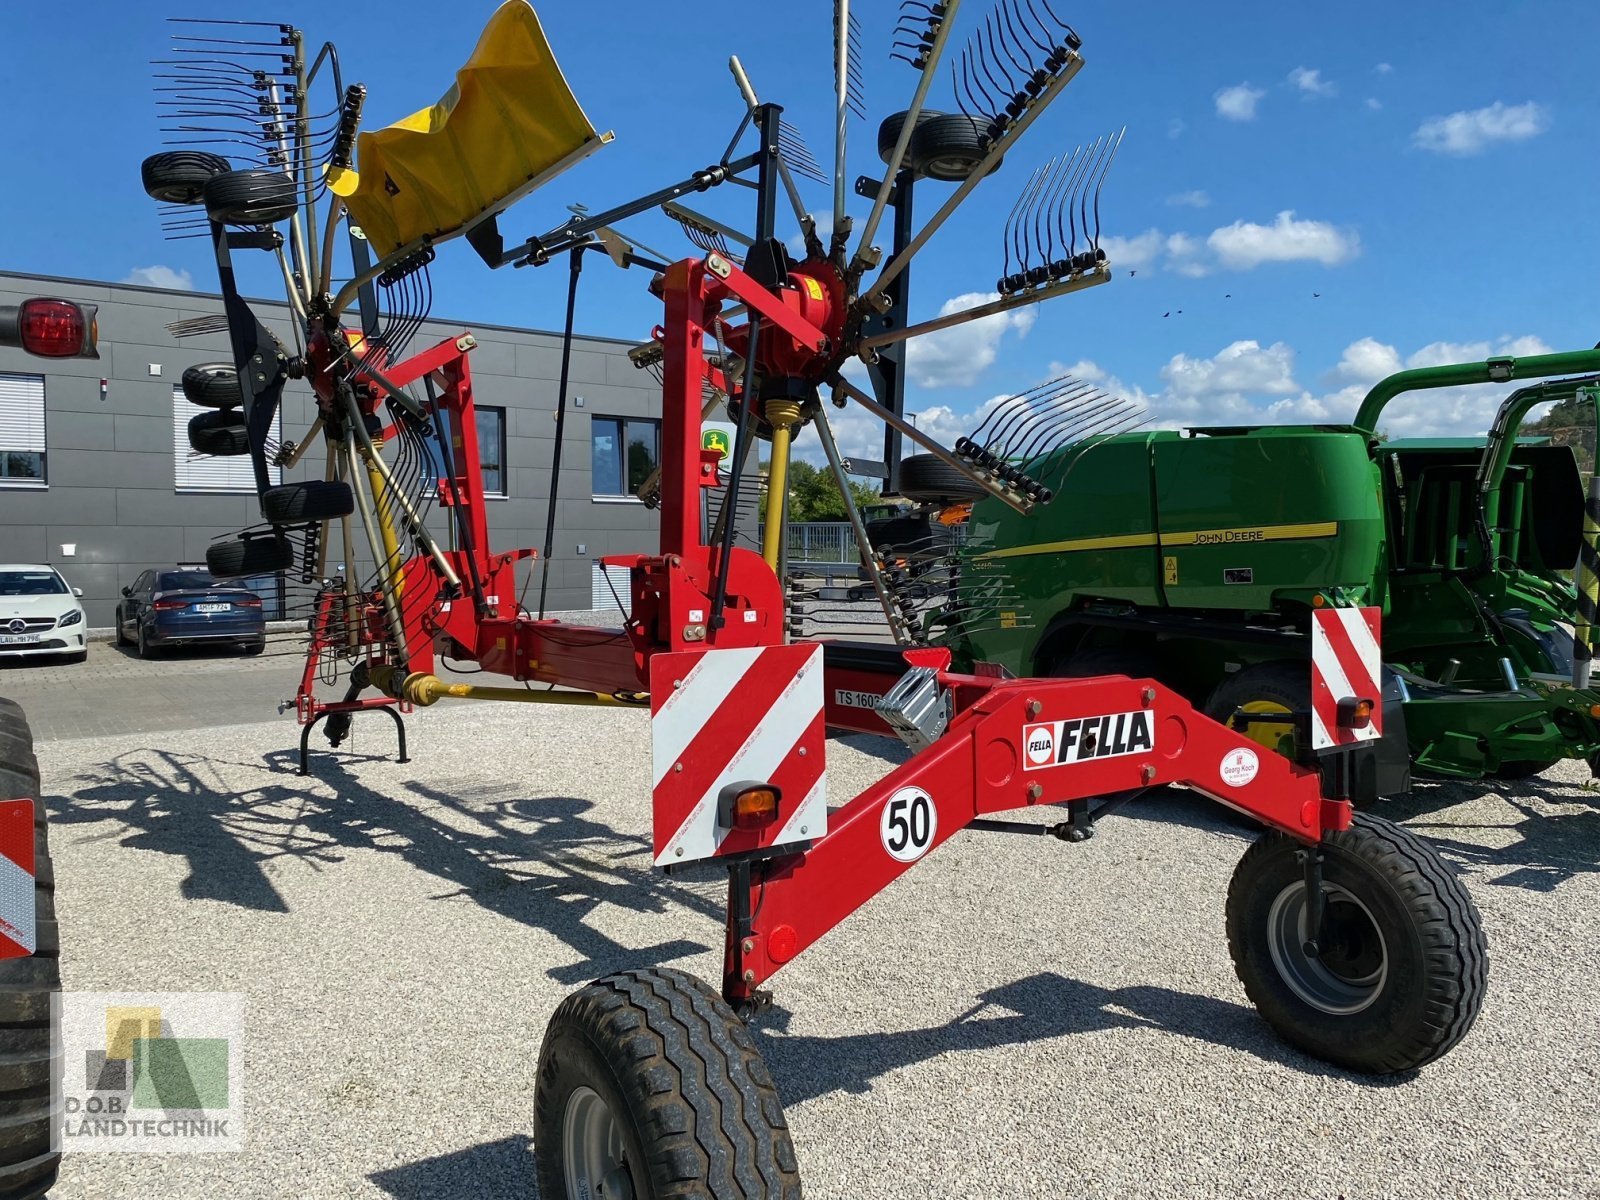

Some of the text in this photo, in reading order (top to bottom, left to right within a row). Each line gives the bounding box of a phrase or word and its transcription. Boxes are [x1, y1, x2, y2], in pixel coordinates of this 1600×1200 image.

[1192, 530, 1264, 544] JOHN DEERE
[838, 691, 853, 705] TS
[1029, 711, 1151, 764] FELLA FELLA
[888, 796, 930, 852] 50
